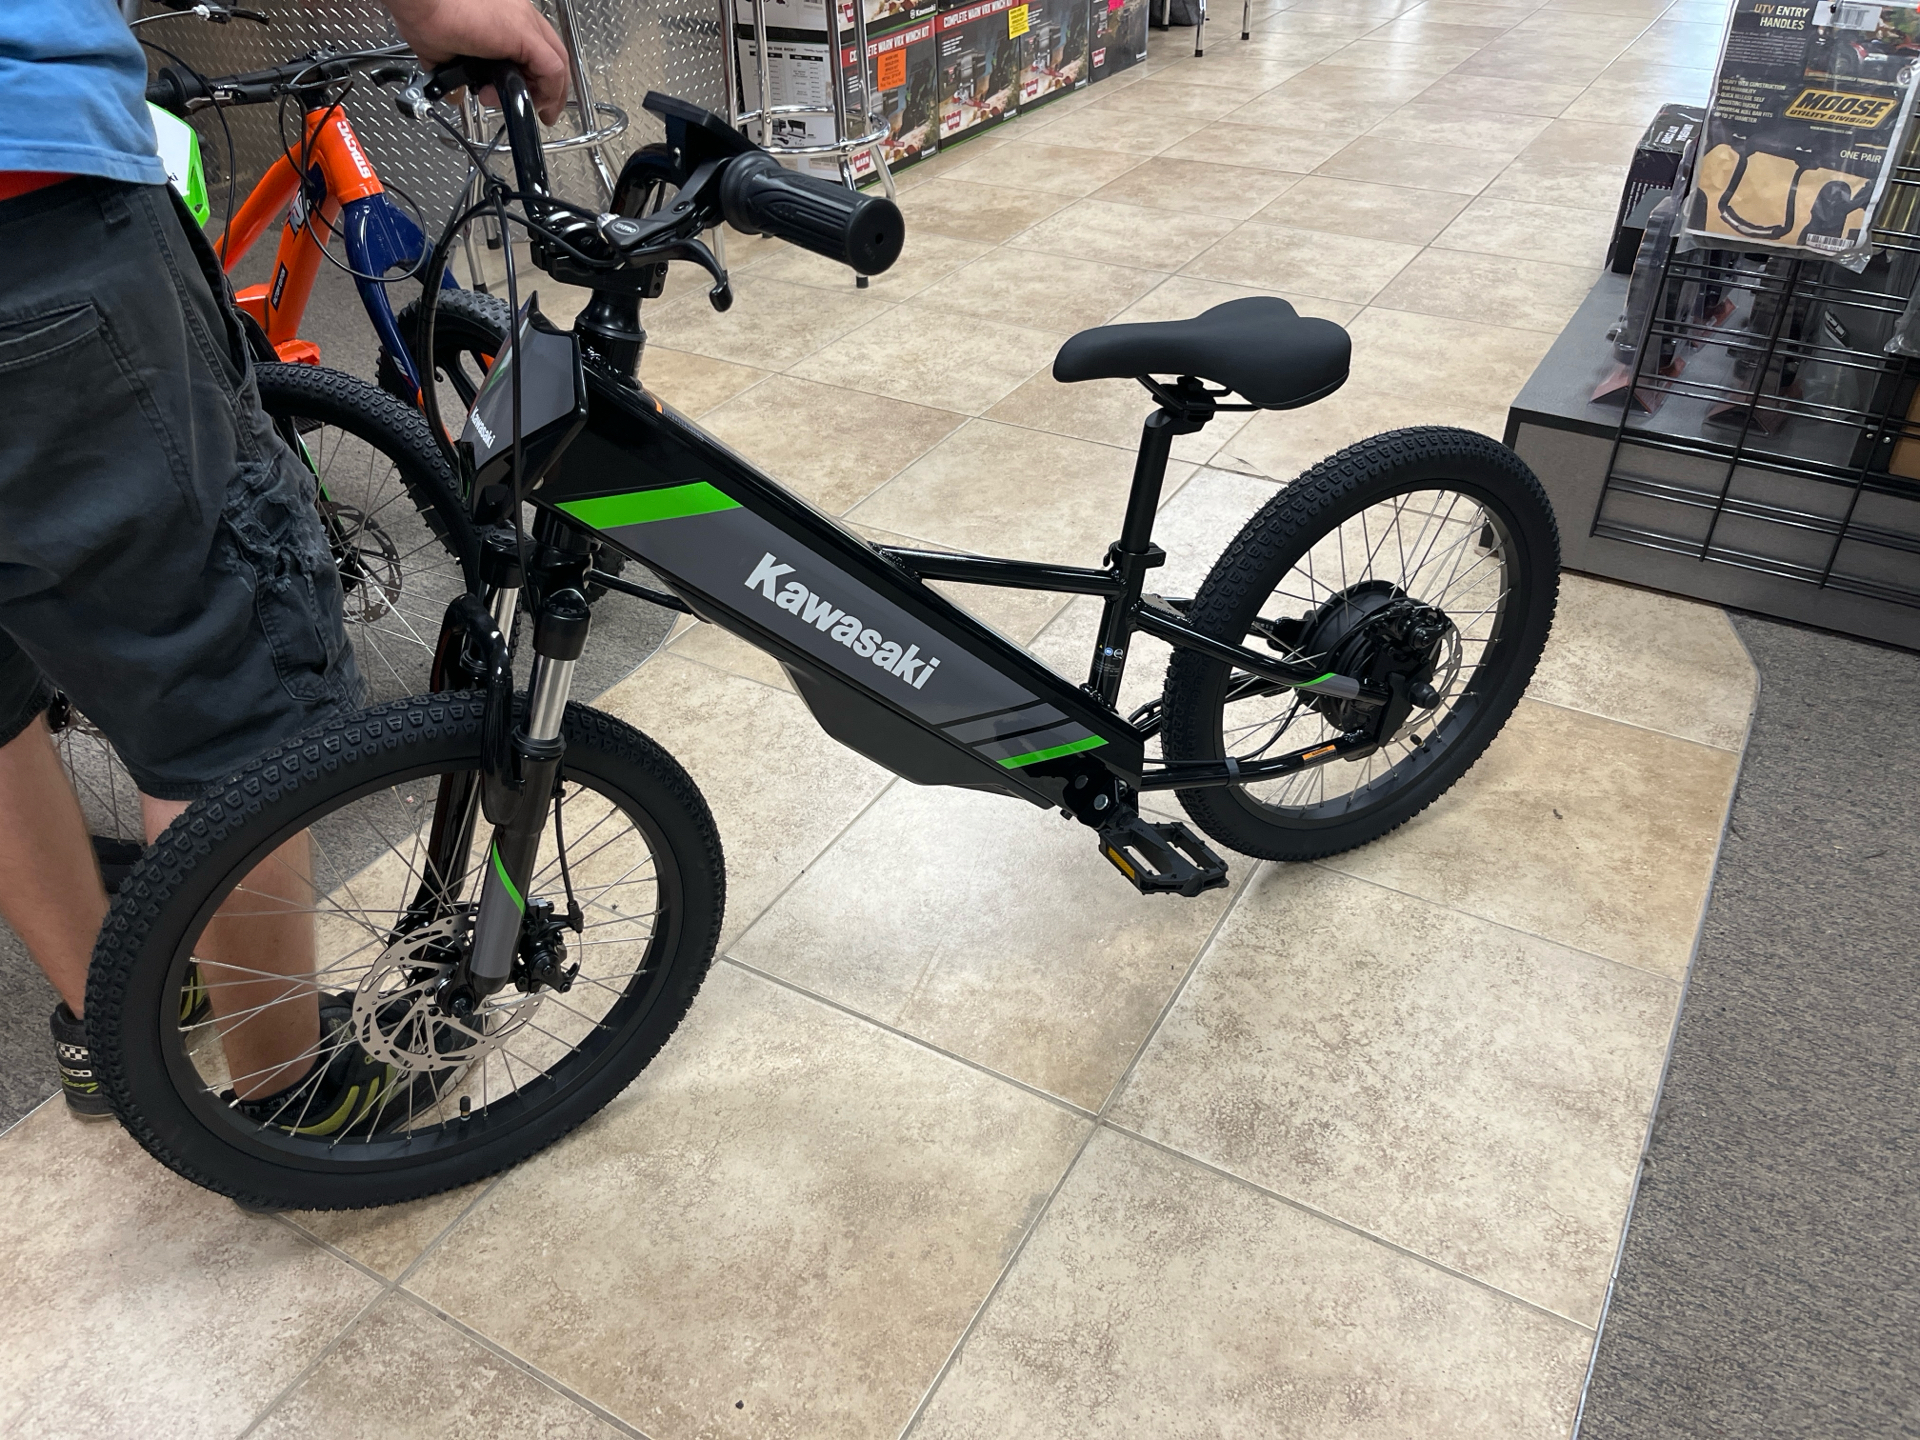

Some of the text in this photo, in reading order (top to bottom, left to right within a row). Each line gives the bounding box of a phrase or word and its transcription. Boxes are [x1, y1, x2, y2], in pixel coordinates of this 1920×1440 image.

[1753, 3, 1810, 18] UTV ENTRY
[1760, 16, 1805, 31] HANDLES
[1796, 92, 1891, 119] MOOSE
[1790, 109, 1876, 125] UTILITY DIVISION
[1840, 150, 1882, 163] ONE PAIR
[470, 405, 496, 449] Kawasaki
[744, 552, 941, 690] Kawasaki
